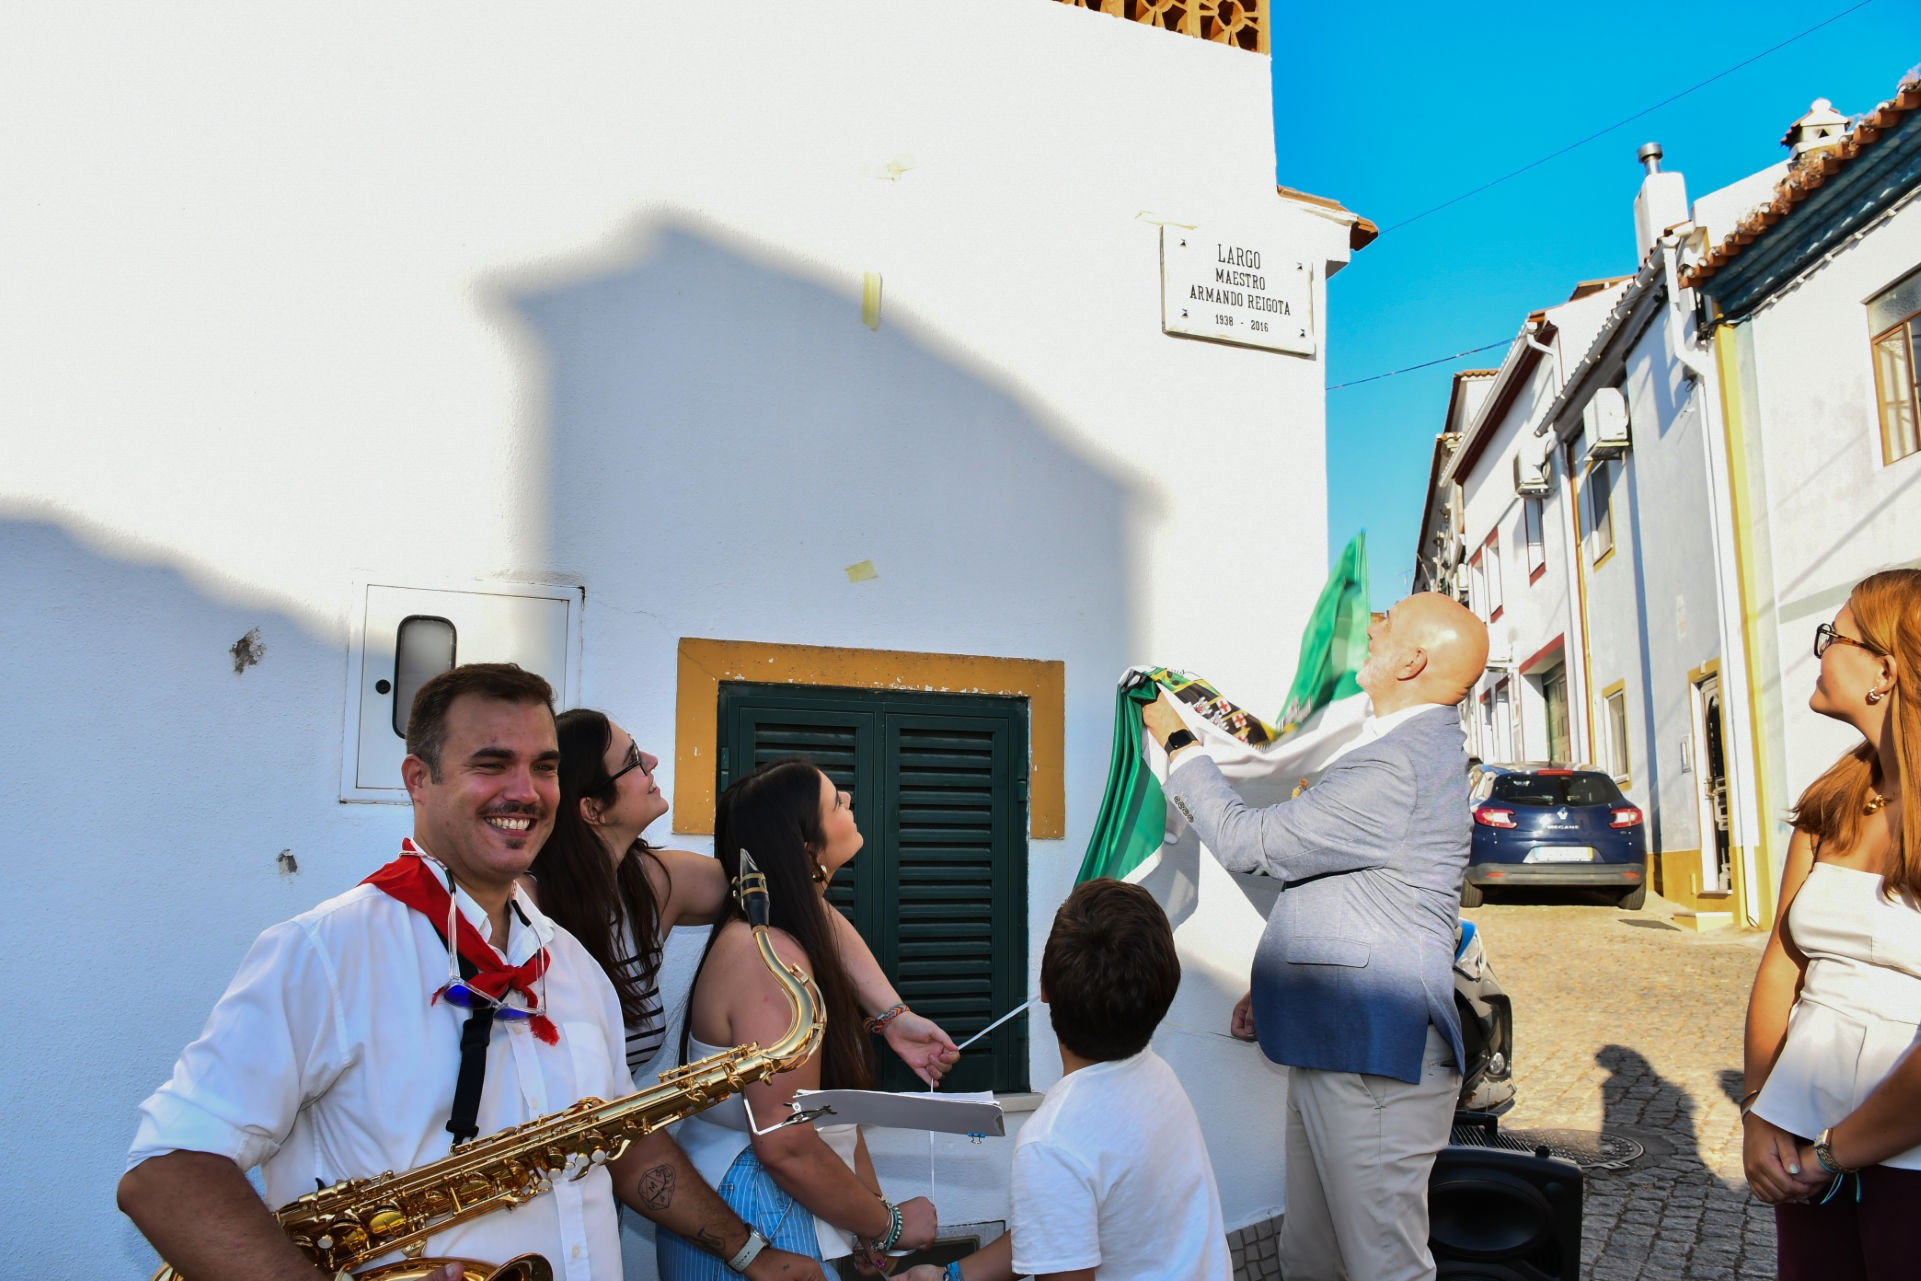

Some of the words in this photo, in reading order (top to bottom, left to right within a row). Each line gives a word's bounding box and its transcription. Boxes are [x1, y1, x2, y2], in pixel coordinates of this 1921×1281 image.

[1217, 243, 1261, 270] LARGO
[1215, 267, 1266, 291] MAESTRO
[1189, 284, 1244, 307] ARMANDO
[1247, 294, 1291, 316] REIGOTA
[1215, 314, 1234, 327] 1938
[1250, 319, 1269, 333] 2016
